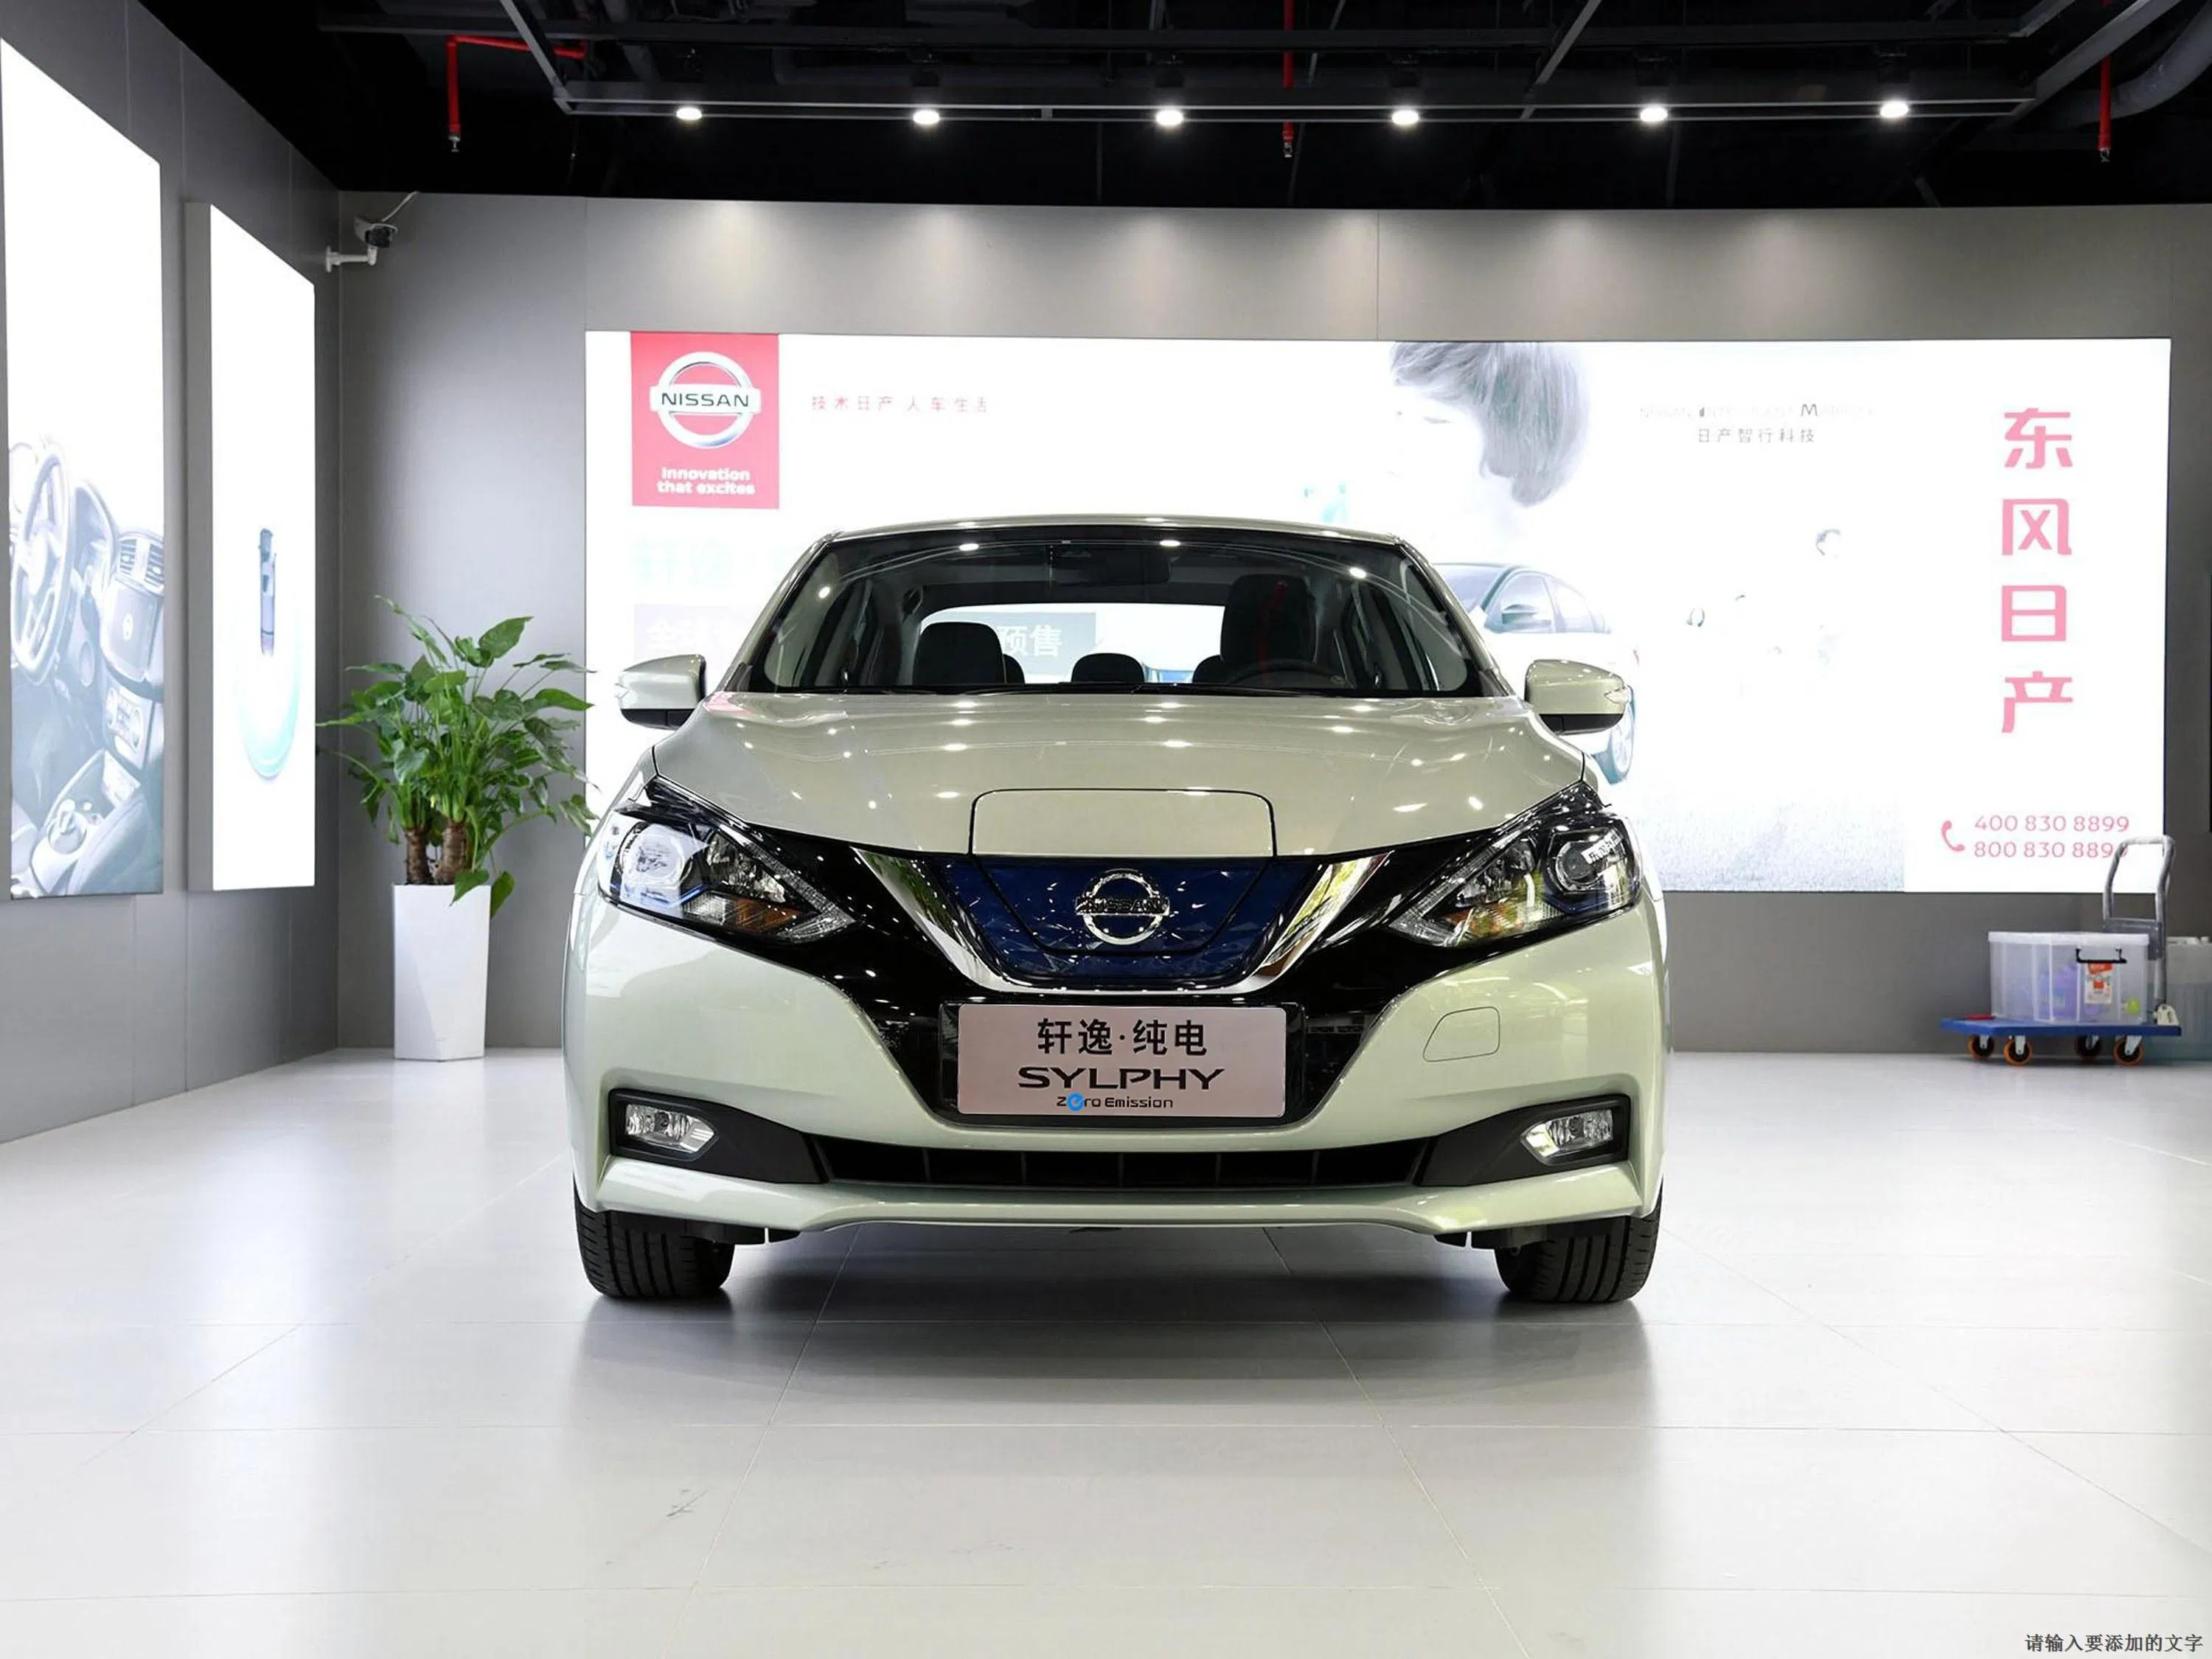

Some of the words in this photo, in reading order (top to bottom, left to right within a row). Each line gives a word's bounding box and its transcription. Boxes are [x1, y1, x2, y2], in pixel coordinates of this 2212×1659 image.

[661, 392, 749, 407] NISSAN
[661, 466, 751, 481] Innovation
[657, 480, 693, 494] that
[696, 481, 756, 495] excites
[2002, 408, 2073, 733] 东风日产
[1974, 815, 2018, 832] 400
[2025, 815, 2067, 832] 830
[2073, 815, 2129, 832] 8899
[1974, 841, 2017, 858] 800
[2023, 841, 2065, 858] 830
[1018, 1066, 1225, 1090] SYLPHY
[1105, 1096, 1173, 1108] Emission
